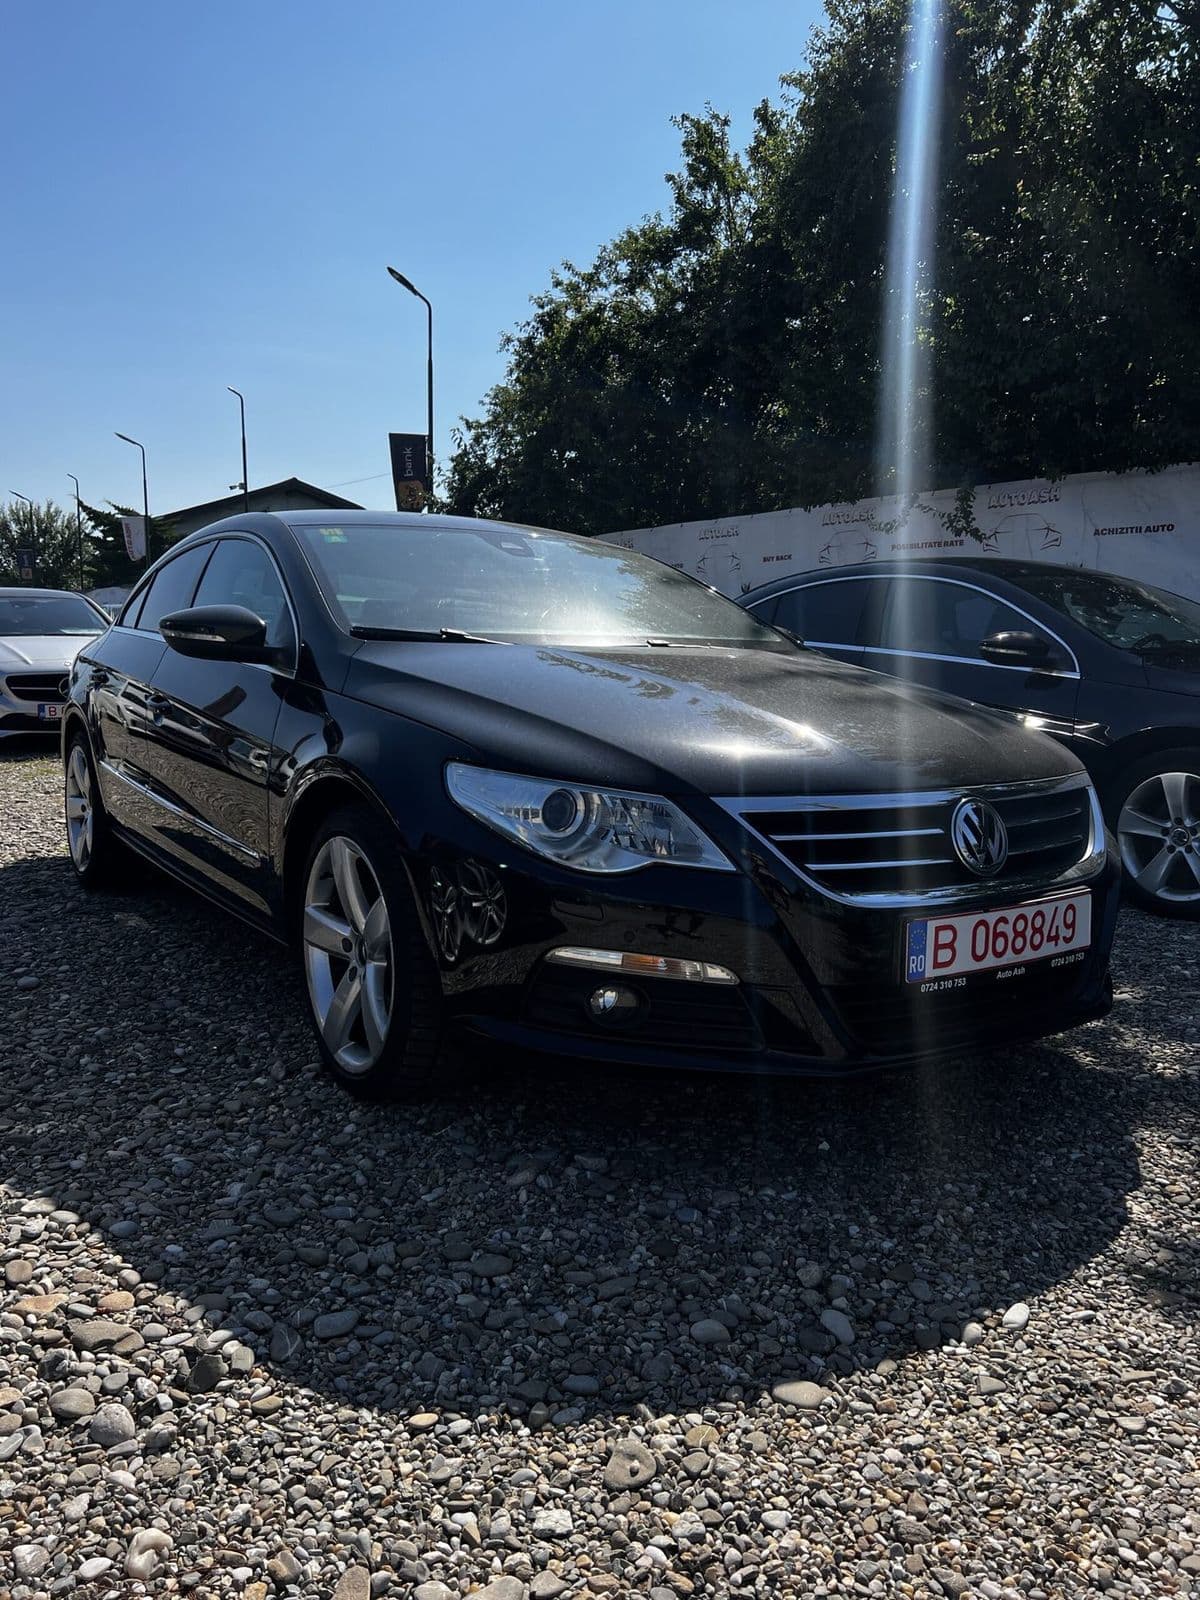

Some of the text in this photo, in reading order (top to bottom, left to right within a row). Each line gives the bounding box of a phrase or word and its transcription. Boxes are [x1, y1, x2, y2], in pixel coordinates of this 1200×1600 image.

[403, 447, 416, 477] bank
[987, 485, 1062, 509] AUTOASH
[1093, 524, 1175, 536] ACHIZITII AUTO
[932, 903, 1076, 969] B 068849
[909, 954, 925, 973] RO
[996, 966, 1026, 980] Auto Ash
[920, 977, 967, 992] 0724 310 753
